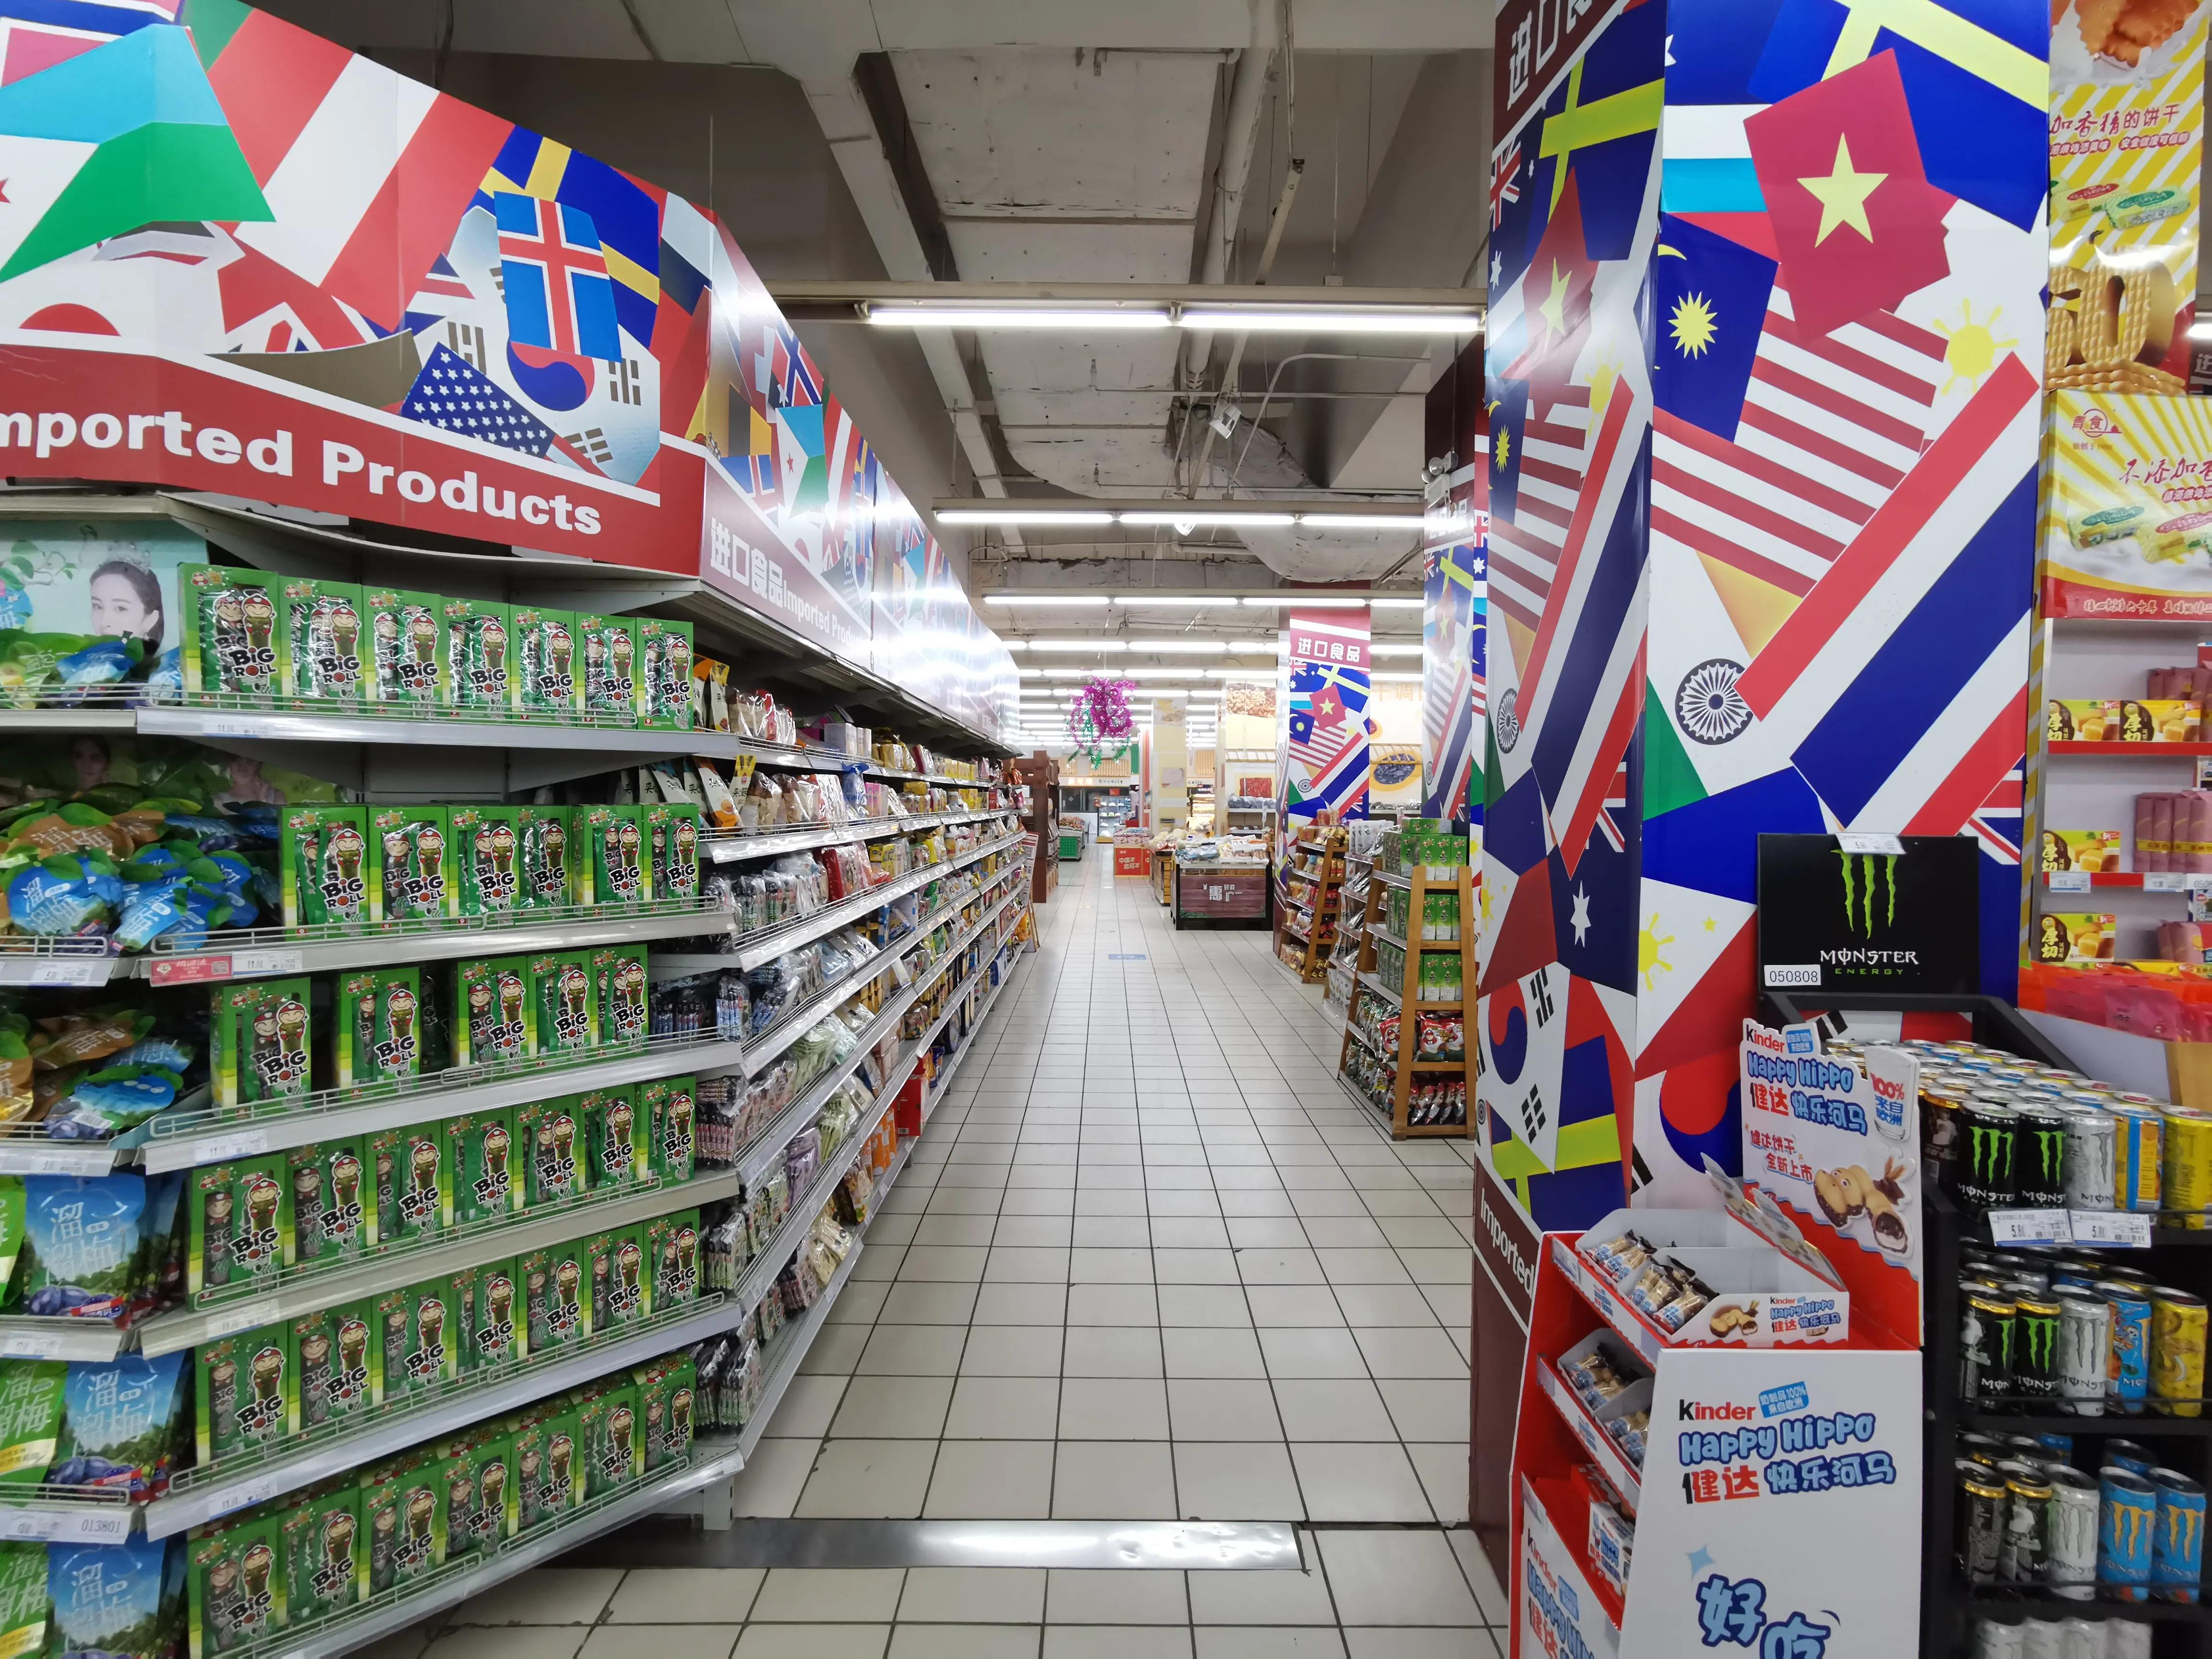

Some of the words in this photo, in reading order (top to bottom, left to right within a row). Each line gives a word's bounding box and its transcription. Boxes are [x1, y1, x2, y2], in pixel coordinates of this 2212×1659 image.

[1507, 0, 1593, 111] 进口
[322, 440, 602, 535] Products
[711, 517, 783, 608] 进口食品
[784, 580, 830, 633] Imported
[1298, 637, 1360, 662] 进口食品
[234, 663, 277, 676] ROLL
[324, 671, 361, 684] ROLL
[404, 677, 439, 689] ROLL
[475, 683, 507, 693] ROLL
[544, 687, 573, 697] ROLL
[607, 691, 633, 701] ROLL
[665, 694, 691, 704] ROLL
[536, 880, 566, 893] ROLL
[612, 879, 641, 892] ROLL
[670, 877, 697, 890] ROLL
[325, 894, 365, 908] ROLL
[409, 891, 446, 905] ROLL
[483, 888, 517, 901] ROLL
[1769, 971, 1818, 983] 050808
[559, 1026, 589, 1041] ROLL
[619, 1018, 646, 1032] ROLL
[493, 1035, 526, 1051] ROLL
[379, 1052, 417, 1069] ROLL
[266, 1067, 308, 1086] ROLL
[1747, 1050, 1796, 1087] Happy
[1799, 1058, 1854, 1093] Hippo
[1871, 1072, 1904, 1100] 100%
[1751, 1082, 1789, 1116] 健达
[1791, 1090, 1867, 1136] 快乐河马
[666, 1146, 693, 1161] ROLL
[606, 1156, 634, 1173] ROLL
[1766, 1153, 1813, 1182] 全新上市
[546, 1170, 577, 1189] ROLL
[477, 1185, 511, 1204] ROLL
[1958, 1182, 2015, 1202] MONSTE
[404, 1201, 440, 1221] ROLL
[324, 1217, 363, 1239] ROLL
[1480, 1187, 1535, 1300] Imported
[235, 1244, 279, 1265] ROLL
[670, 1278, 697, 1296] ROLL
[613, 1298, 642, 1315] ROLL
[1771, 1306, 1803, 1320] Happy
[1803, 1299, 1835, 1314] Hippo
[550, 1314, 580, 1335] ROLL
[481, 1332, 515, 1355] ROLL
[409, 1357, 445, 1379] ROLL
[329, 1382, 369, 1406] ROLL
[240, 1409, 285, 1436] ROLL
[664, 1434, 692, 1452] ROLL
[1679, 1426, 1776, 1466] Happy
[1780, 1412, 1876, 1453] Hippo
[604, 1458, 633, 1479] ROLL
[1682, 1465, 1760, 1504] 健达
[1764, 1450, 1897, 1494] 快乐河马
[540, 1487, 572, 1509] ROLL
[81, 1518, 121, 1533] 013801
[470, 1514, 505, 1538] ROLL
[397, 1547, 434, 1571] ROLL
[315, 1571, 354, 1599] ROLL
